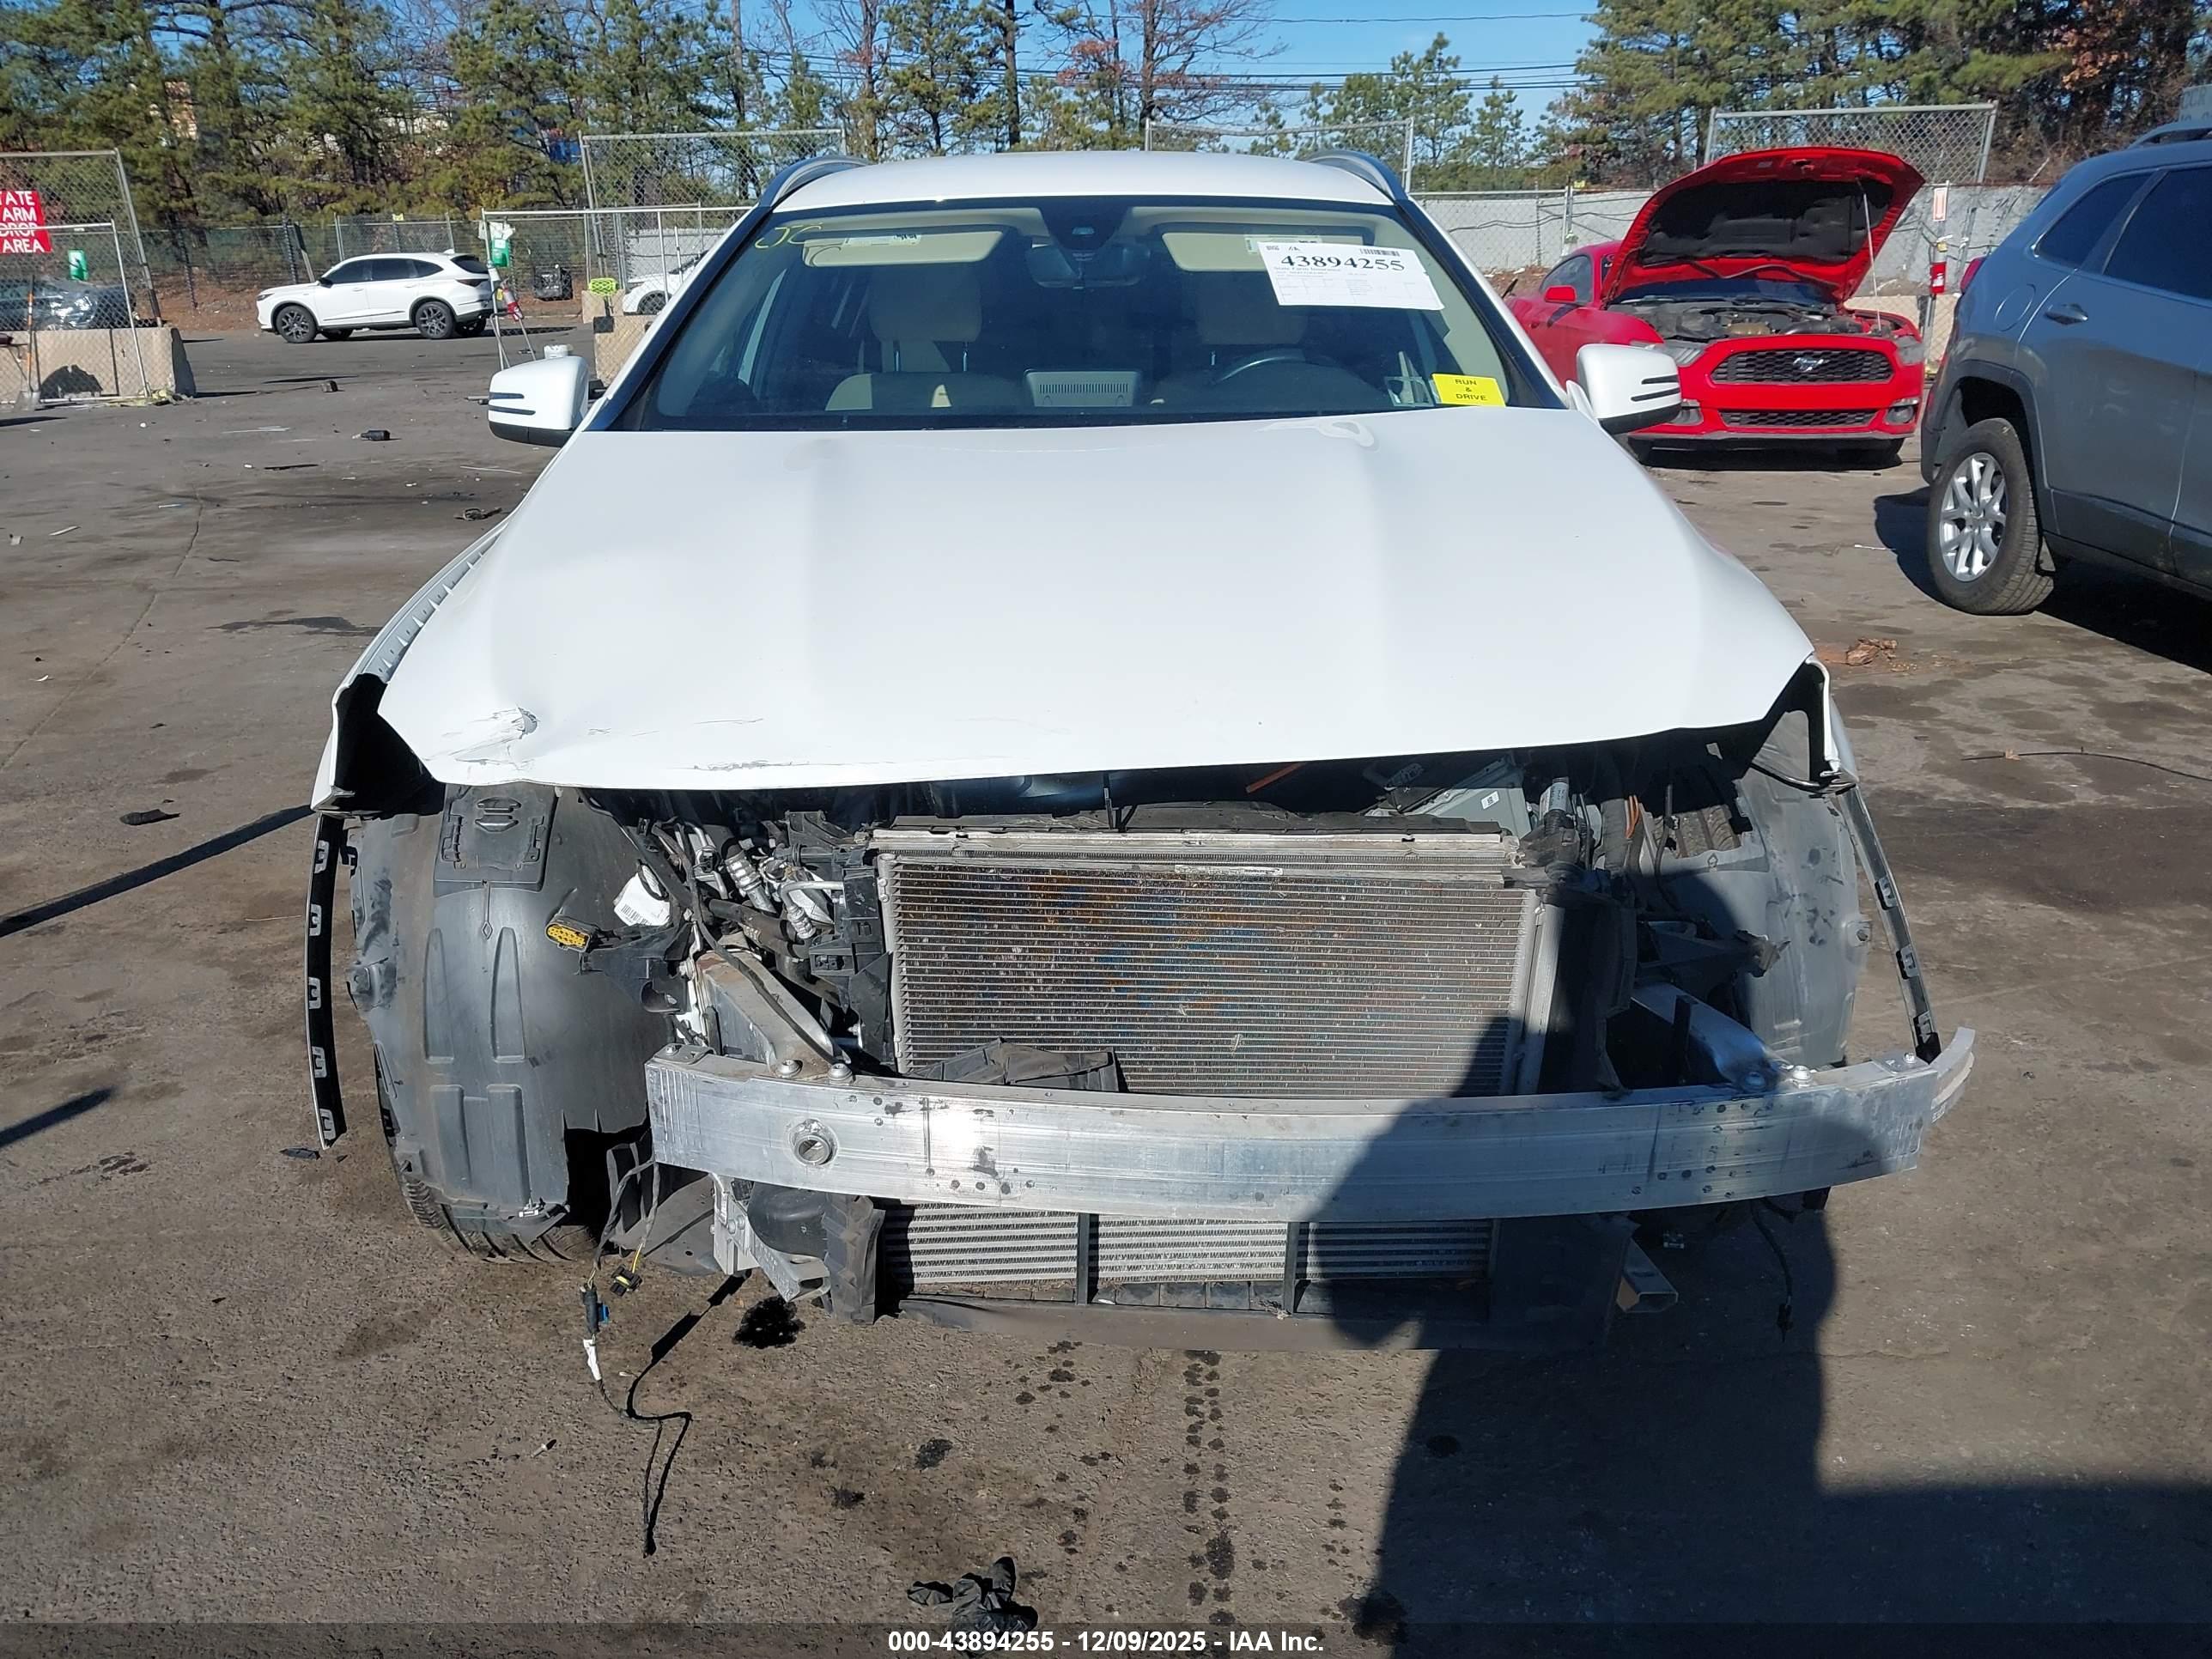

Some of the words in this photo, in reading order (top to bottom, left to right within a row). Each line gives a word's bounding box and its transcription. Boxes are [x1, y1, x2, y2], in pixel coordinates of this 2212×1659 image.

[0, 191, 35, 206] ATE
[3, 239, 45, 253] AREA
[1281, 255, 1405, 271] 43894255
